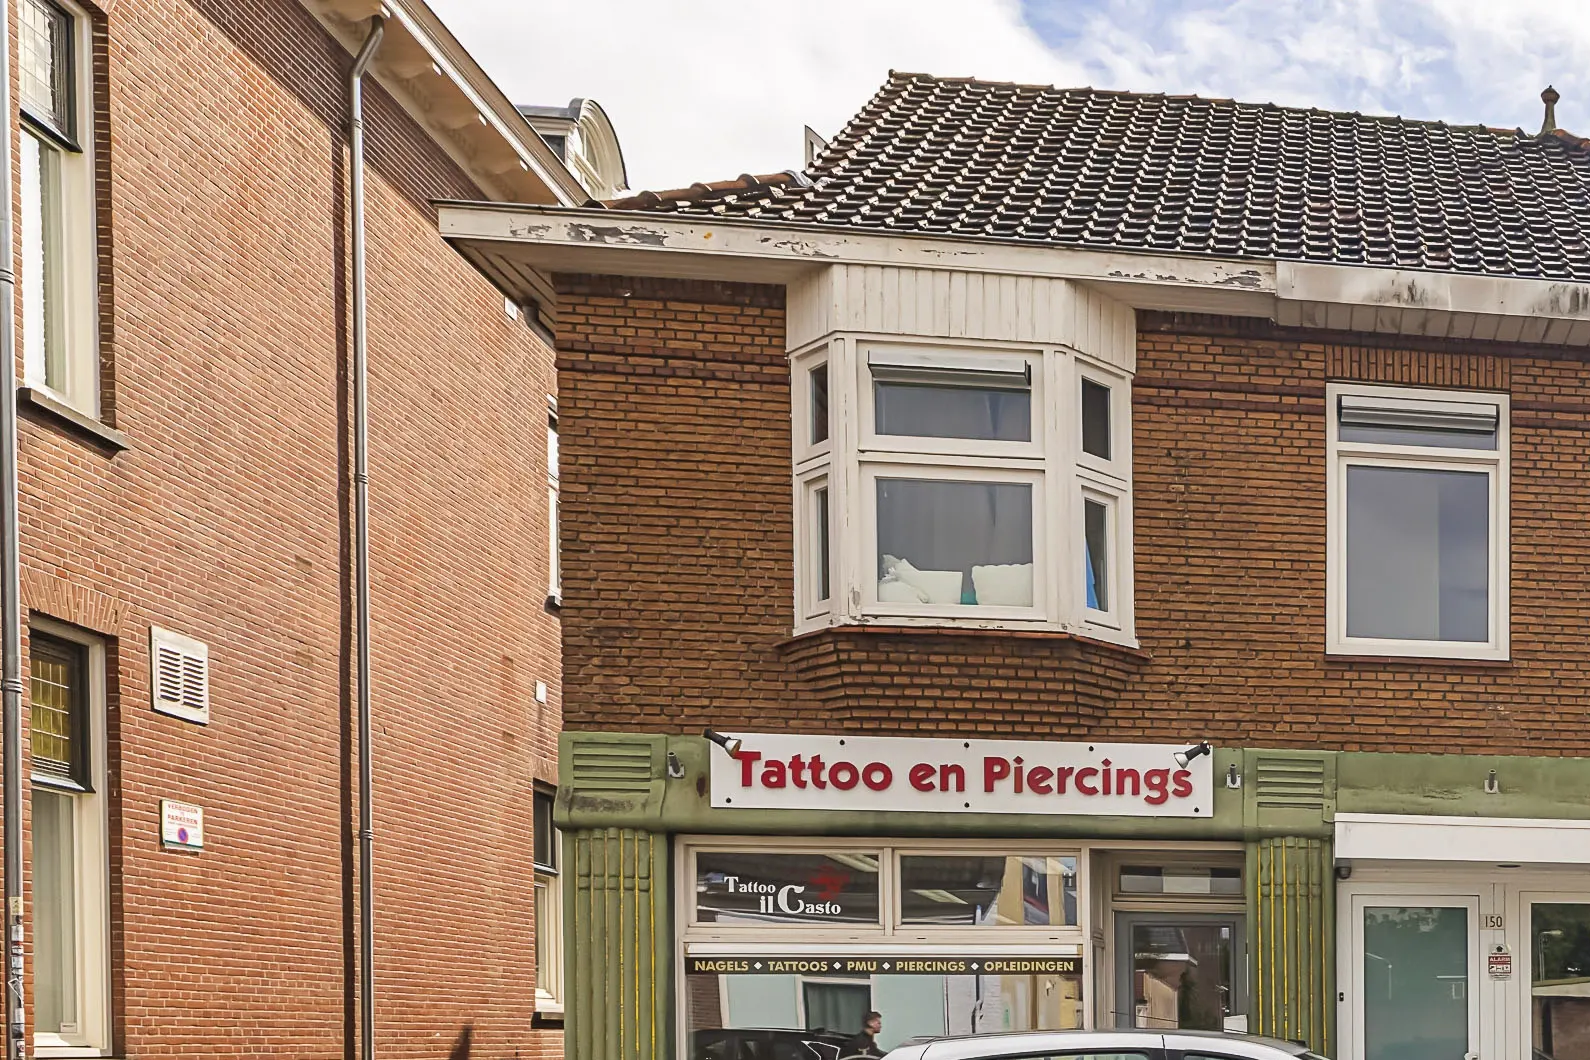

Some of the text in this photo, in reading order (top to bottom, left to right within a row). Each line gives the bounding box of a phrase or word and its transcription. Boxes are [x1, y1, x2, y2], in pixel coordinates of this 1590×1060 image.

[733, 751, 1193, 806] Tattoo en Piercings
[724, 876, 776, 893] Tattoo
[760, 885, 842, 914] il Casto
[1485, 916, 1503, 928] 150
[694, 960, 1074, 972] NAGELS TATTOOS PMU PIERCINGS OPLEIDINGEN
